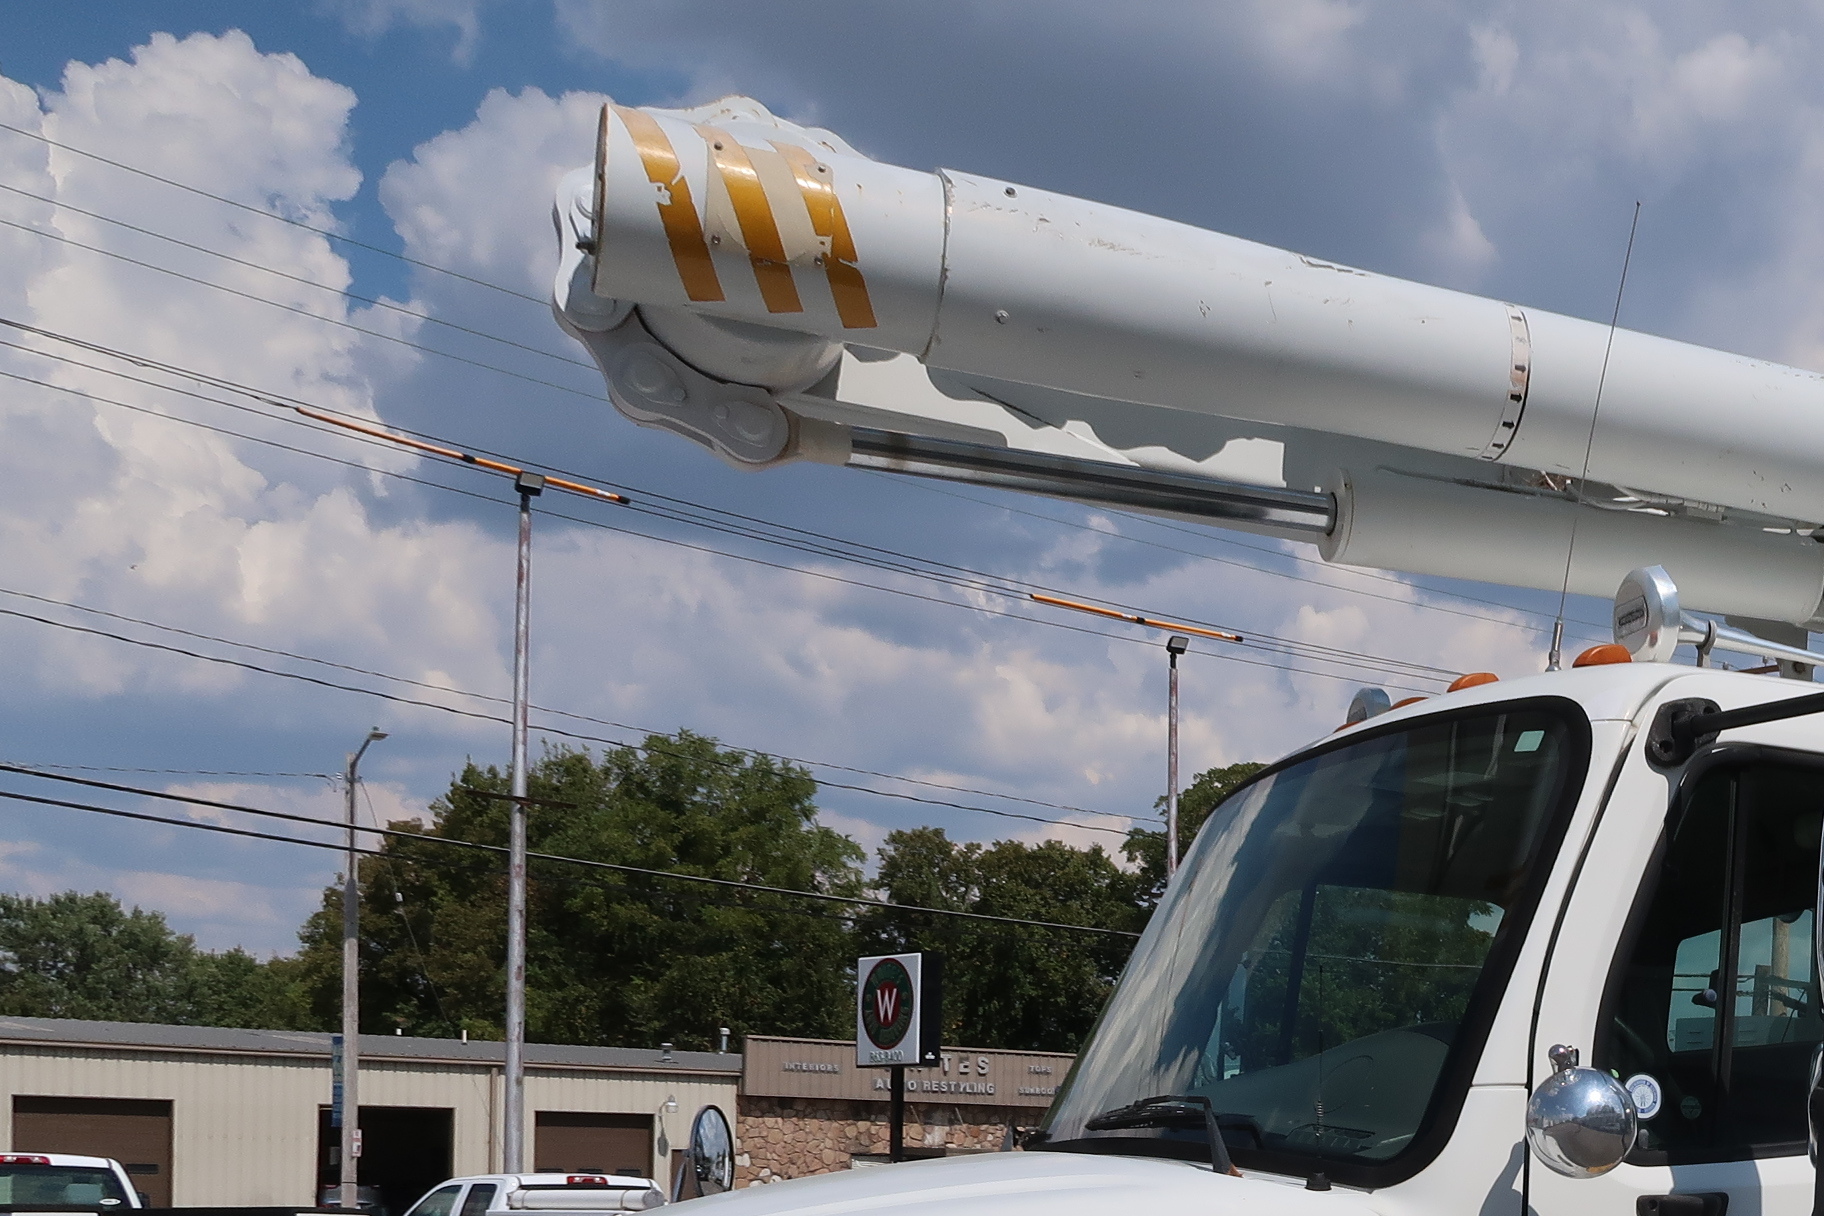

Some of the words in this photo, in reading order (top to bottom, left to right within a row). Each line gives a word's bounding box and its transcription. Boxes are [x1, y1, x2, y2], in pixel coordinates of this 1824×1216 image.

[876, 987, 898, 1023] W
[782, 1061, 840, 1073] INTERIORS
[1029, 1065, 1053, 1074] TOPS
[875, 1078, 917, 1092] AUO
[922, 1080, 996, 1095] RESTYLING
